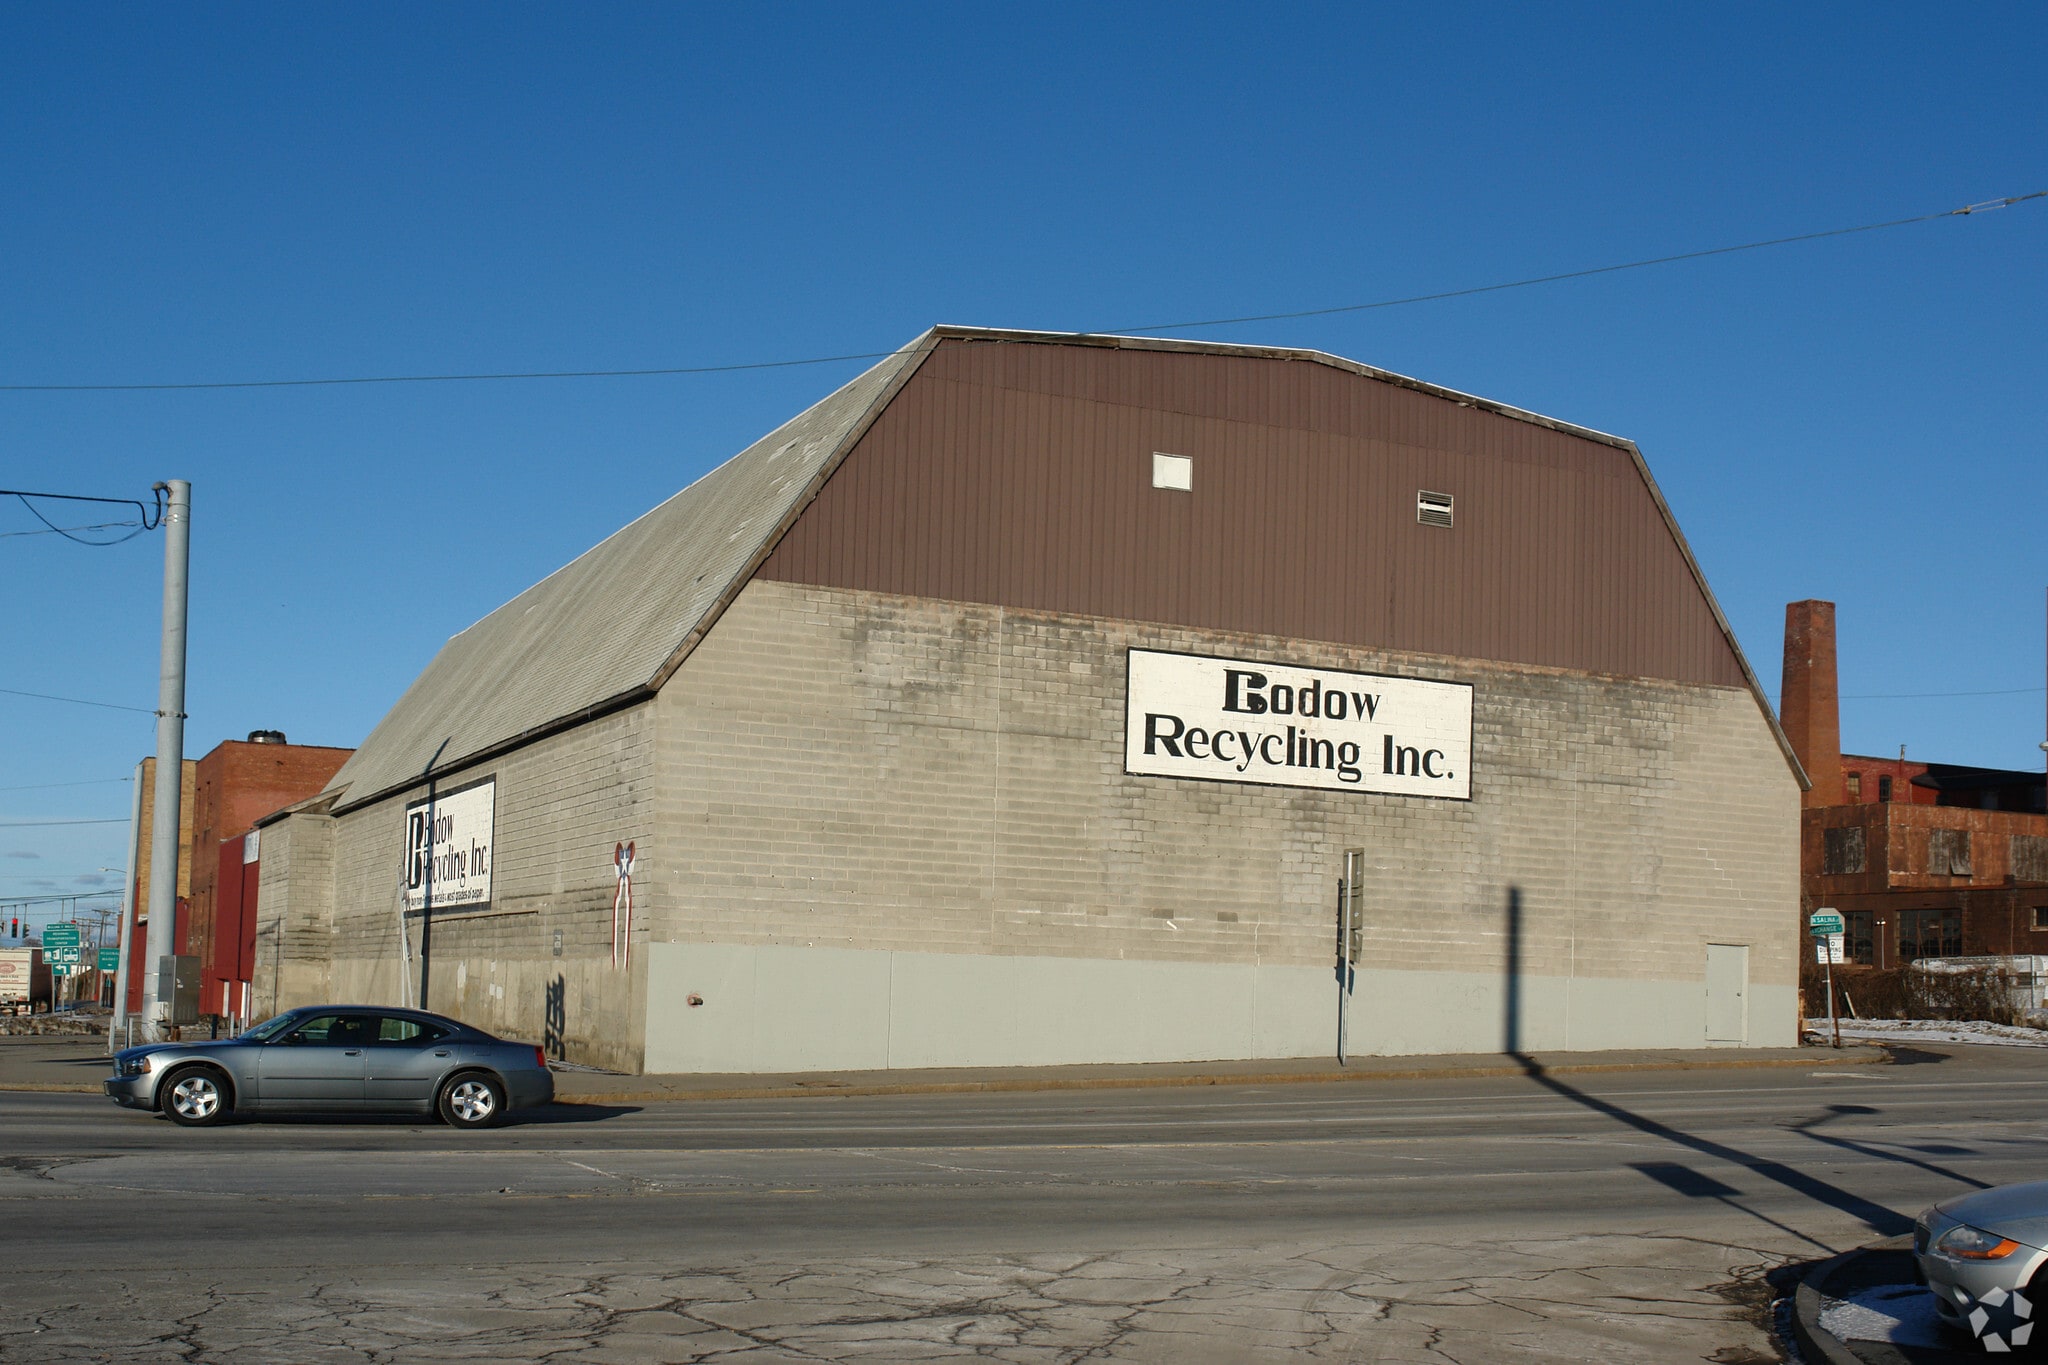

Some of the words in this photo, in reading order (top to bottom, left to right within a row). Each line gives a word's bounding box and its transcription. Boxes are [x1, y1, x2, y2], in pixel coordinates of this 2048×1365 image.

[1222, 668, 1382, 723] Bodow
[1142, 712, 1362, 783] Recycling
[1382, 734, 1455, 780] Inc.
[424, 808, 455, 848] Bodow
[422, 844, 467, 891] Recycling
[470, 838, 488, 877] Inc.
